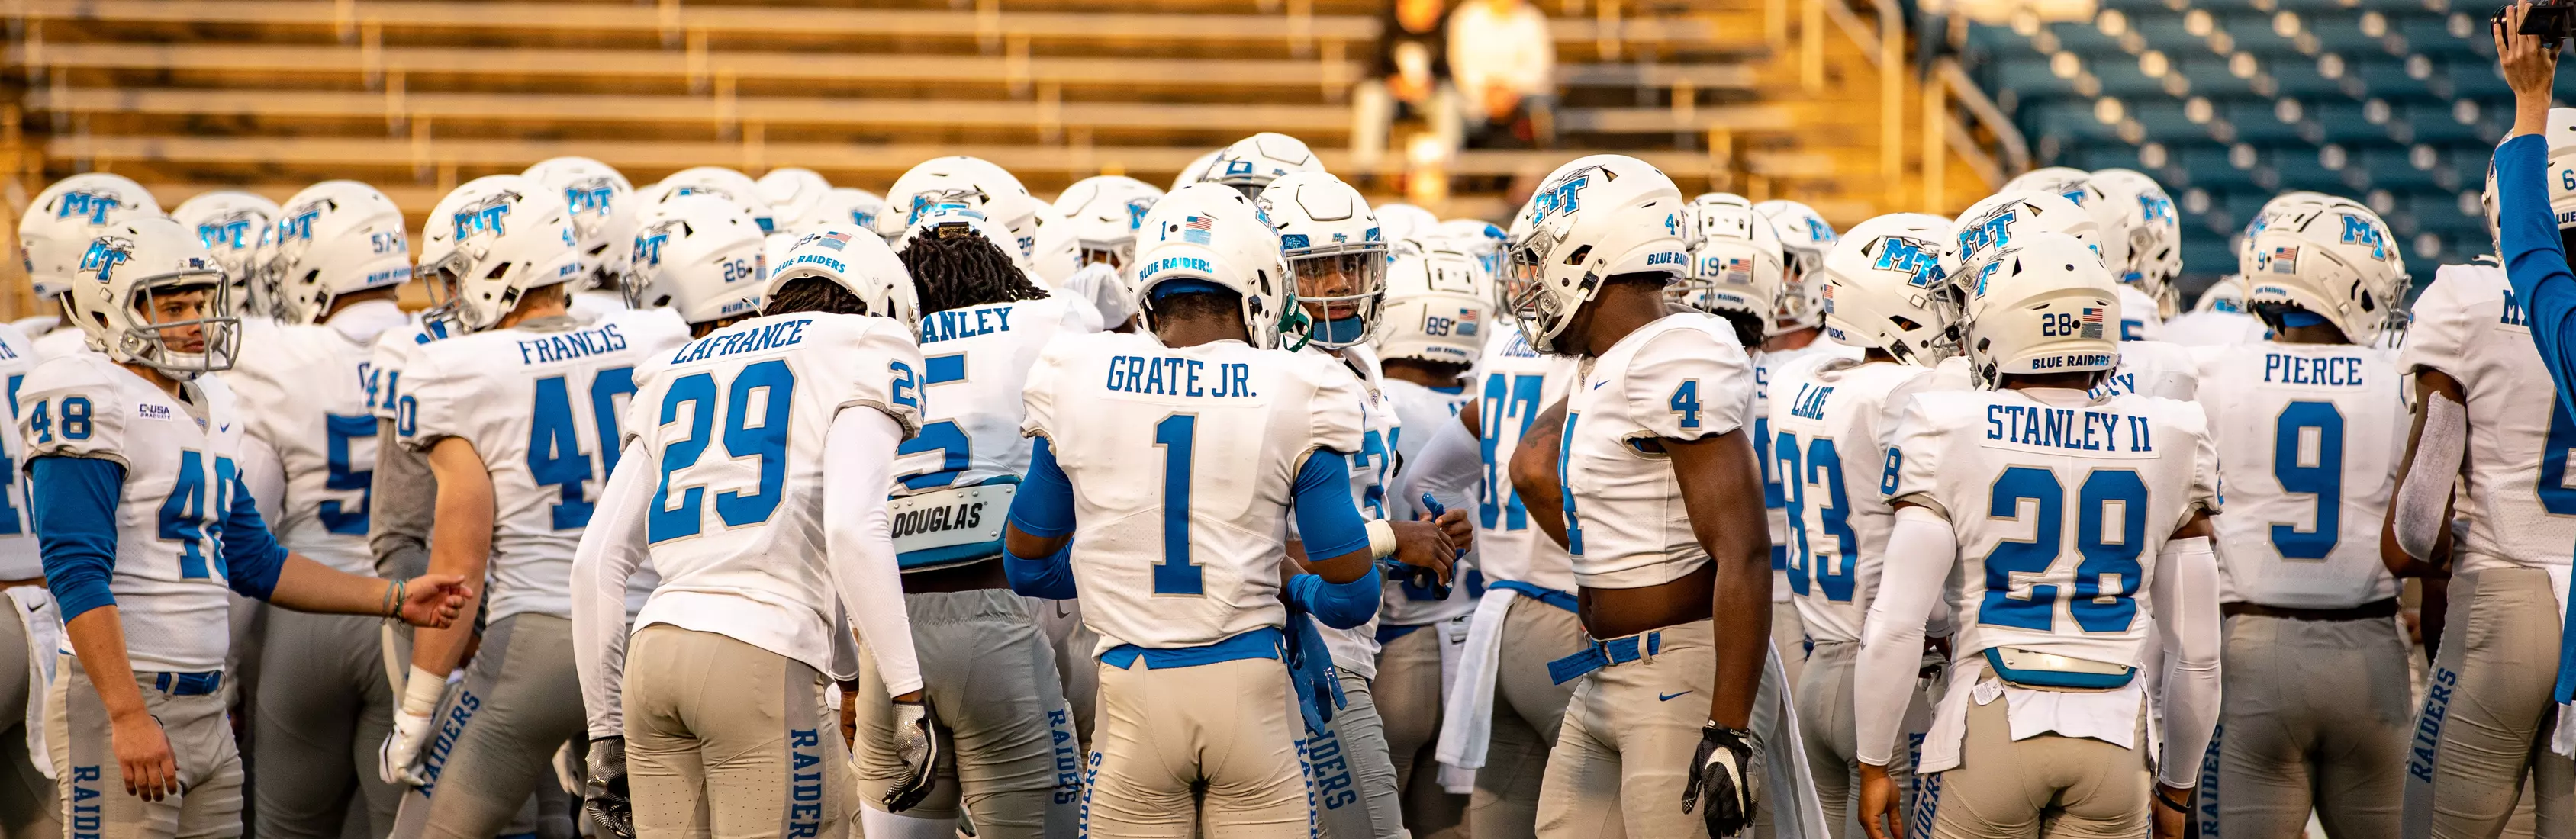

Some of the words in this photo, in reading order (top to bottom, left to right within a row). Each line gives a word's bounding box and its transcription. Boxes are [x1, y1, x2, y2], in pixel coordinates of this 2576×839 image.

[1533, 175, 1589, 228] MT
[2557, 211, 2576, 225] LUE
[452, 201, 512, 246] MT
[1160, 220, 1167, 242] 1
[1665, 213, 1676, 236] 4
[1958, 209, 2016, 265] MT
[78, 238, 129, 284] MT
[723, 259, 747, 283] 26
[771, 257, 794, 278] BLUE
[797, 255, 846, 274] RAIDERS
[1139, 261, 1159, 282] BLUE
[1162, 257, 1214, 275] RAIDERS
[1647, 252, 1672, 266] BLUE
[1699, 256, 1721, 277] 19
[1872, 236, 1941, 289] MT
[2258, 250, 2266, 271] 9
[517, 323, 627, 365] FRANCIS
[671, 319, 813, 365] LAFRANCE
[921, 306, 1013, 345] ANLEY
[1426, 316, 1450, 337] 89
[2042, 313, 2072, 336] 28
[1106, 355, 1203, 397] GRATE
[1211, 363, 1257, 397] JR.
[2032, 356, 2062, 370] BLUE
[2067, 355, 2111, 367] RAIDERS
[2263, 353, 2363, 386] PIERCE
[31, 395, 94, 445] 48
[1668, 378, 1704, 431] 4
[1791, 382, 1834, 420] LANE
[1987, 404, 2120, 452] STANLEY
[2128, 415, 2153, 452] II
[647, 356, 800, 548] 29
[2268, 397, 2348, 563] 9
[1150, 410, 1206, 598] 1
[1775, 428, 1861, 606] 83
[1975, 463, 2153, 635] 28
[2410, 667, 2457, 784] RAIDERS
[787, 728, 823, 839] RAIDER
[1306, 729, 1357, 811] IDERS
